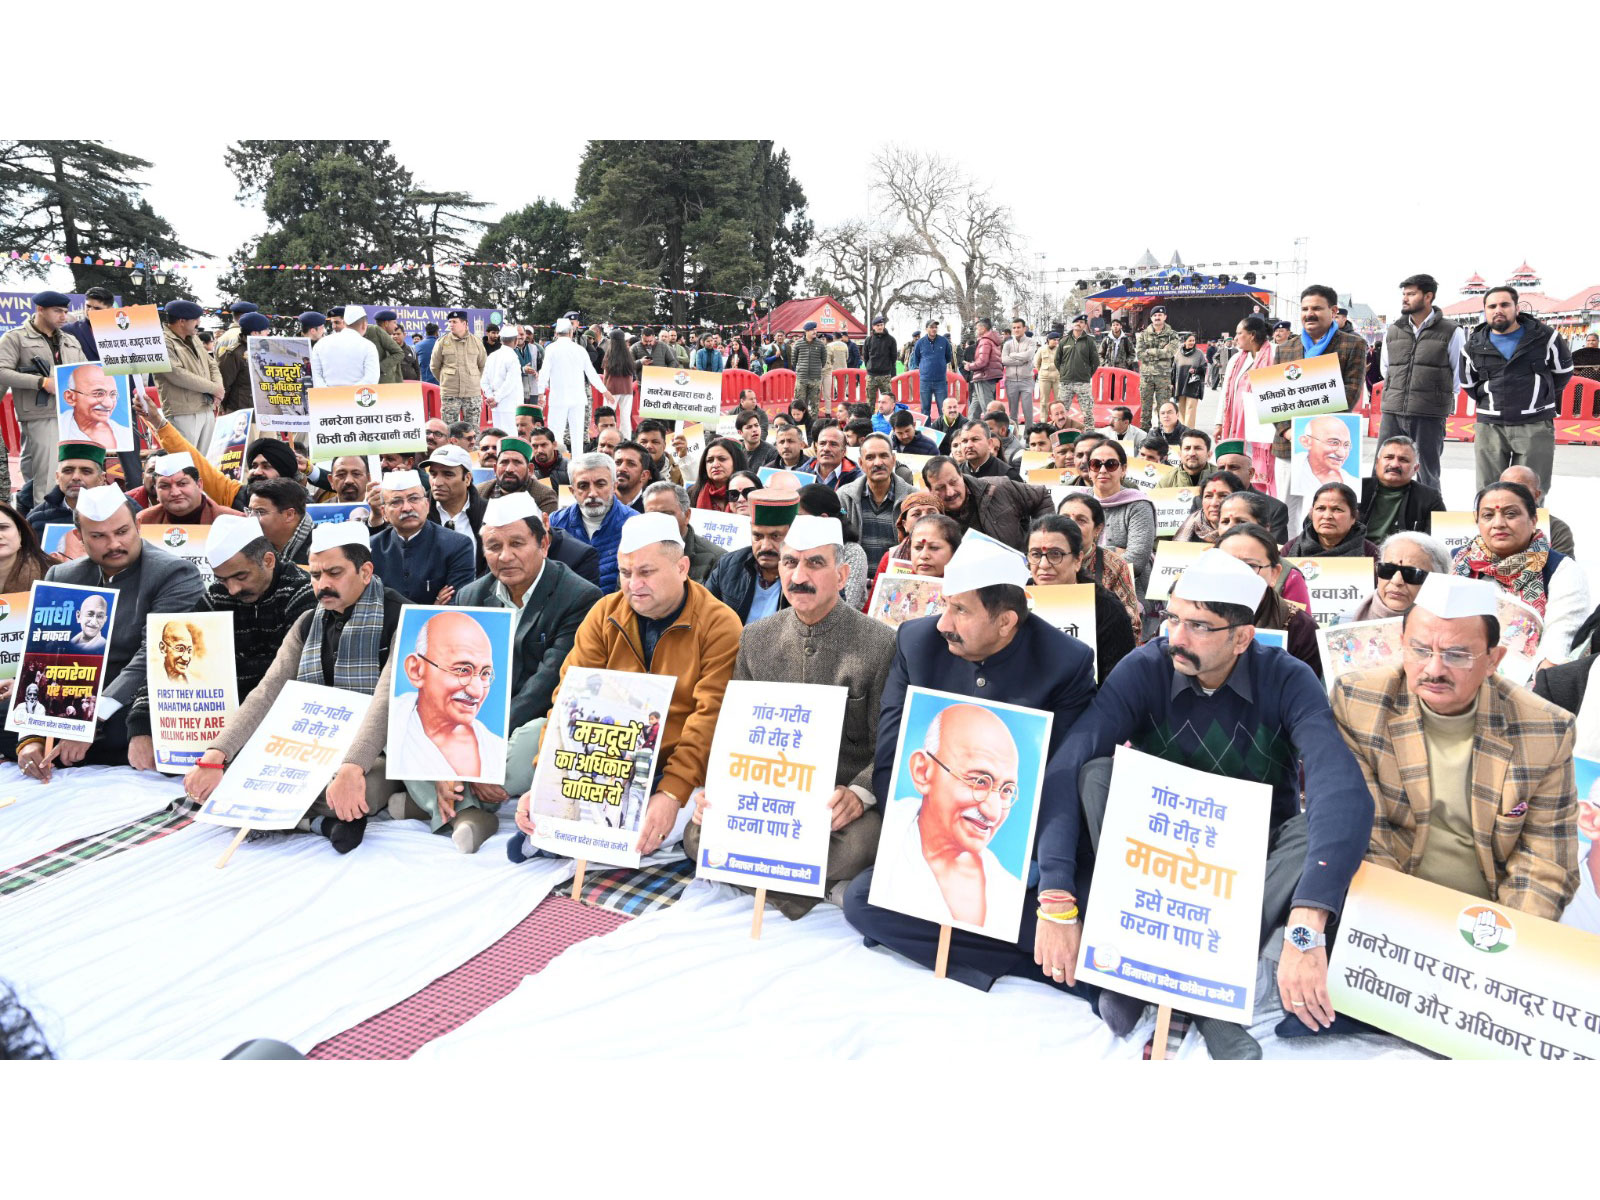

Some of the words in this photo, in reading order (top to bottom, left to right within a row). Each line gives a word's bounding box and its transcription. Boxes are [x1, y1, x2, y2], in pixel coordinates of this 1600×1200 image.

[391, 309, 429, 319] HIMLA
[264, 362, 302, 383] मजदूरों
[260, 382, 270, 391] का
[273, 380, 303, 392] अधिकार
[647, 388, 671, 396] मनरेगा
[672, 390, 692, 398] हमारा
[1259, 389, 1286, 402] श्रमिकों
[1288, 387, 1296, 396] के
[1298, 382, 1327, 394] सम्मान
[1328, 379, 1336, 388] में
[268, 394, 291, 405] वापिस
[292, 394, 302, 405] दो
[644, 399, 660, 408] किसी
[662, 401, 671, 409] की
[673, 402, 702, 412] मेहरबानी
[1271, 402, 1295, 413] कांग्रेस
[320, 414, 353, 426] मनरेगा
[356, 415, 383, 425] हमारा
[385, 413, 402, 423] हक
[317, 433, 341, 444] किसी
[344, 431, 356, 442] की
[359, 429, 400, 442] मेहरबानी
[403, 428, 420, 439] नहीं
[704, 521, 739, 534] गांव-गरीब
[727, 536, 733, 545] है
[34, 600, 75, 626] गांधी
[32, 629, 41, 642] से
[42, 630, 72, 642] नफरत
[45, 662, 98, 681] मनरेगा
[47, 685, 61, 696] पर
[62, 685, 94, 698] हमला
[157, 689, 174, 698] FIRST
[176, 689, 194, 698] THEY
[196, 689, 224, 698] KILLED
[158, 702, 191, 711] MAHATMA
[193, 702, 225, 711] GANDHI
[302, 701, 353, 722] गांव-गरीब
[752, 703, 812, 724] गांव-गरीब
[160, 717, 176, 728] NOW
[178, 717, 201, 728] THEY
[204, 717, 225, 728] ARE
[292, 719, 309, 732] की
[308, 722, 329, 739] रीढ़
[329, 724, 340, 738] है
[161, 730, 184, 741] KILLING
[186, 732, 198, 741] HIS
[201, 731, 220, 741] NAM
[573, 720, 643, 759] मजदूरों
[749, 726, 766, 744] की
[768, 728, 790, 751] रीढ़
[792, 730, 803, 748] है
[265, 735, 340, 765] मनरेगा
[259, 764, 281, 777] इसे
[555, 750, 576, 770] का
[575, 751, 633, 779] अधिकार
[729, 751, 816, 792] मनरेगा
[276, 781, 297, 794] पाप
[562, 776, 606, 803] वापिस
[606, 781, 623, 806] दो
[738, 792, 760, 811] इसे
[762, 797, 795, 816] खत्म
[1152, 786, 1227, 821] गांव-गरीब
[728, 815, 764, 834] करना
[767, 820, 790, 838] पाप
[792, 819, 802, 839] है
[1148, 812, 1170, 836] की
[1173, 820, 1202, 848] रीढ़
[1205, 825, 1218, 848] है
[1125, 837, 1238, 900] मनरेगा
[1135, 889, 1163, 912] इसे
[1166, 898, 1211, 924] खत्म
[1120, 910, 1170, 940] करना
[1173, 924, 1203, 950] पाप
[1208, 929, 1221, 953] है
[1121, 963, 1158, 984] हिमाचल
[1158, 973, 1180, 992] प्रदेश
[1348, 928, 1411, 965] मनरेगा
[1414, 951, 1440, 977] पर
[1442, 962, 1478, 990] वार,
[1484, 977, 1548, 1018] मजदूर
[1551, 1000, 1580, 1028] पर
[1584, 1010, 1600, 1034] वा
[1344, 965, 1412, 1008] संविधान
[1414, 993, 1453, 1025] और
[1455, 1011, 1536, 1056] अधिकार
[1540, 1039, 1568, 1060] पर
